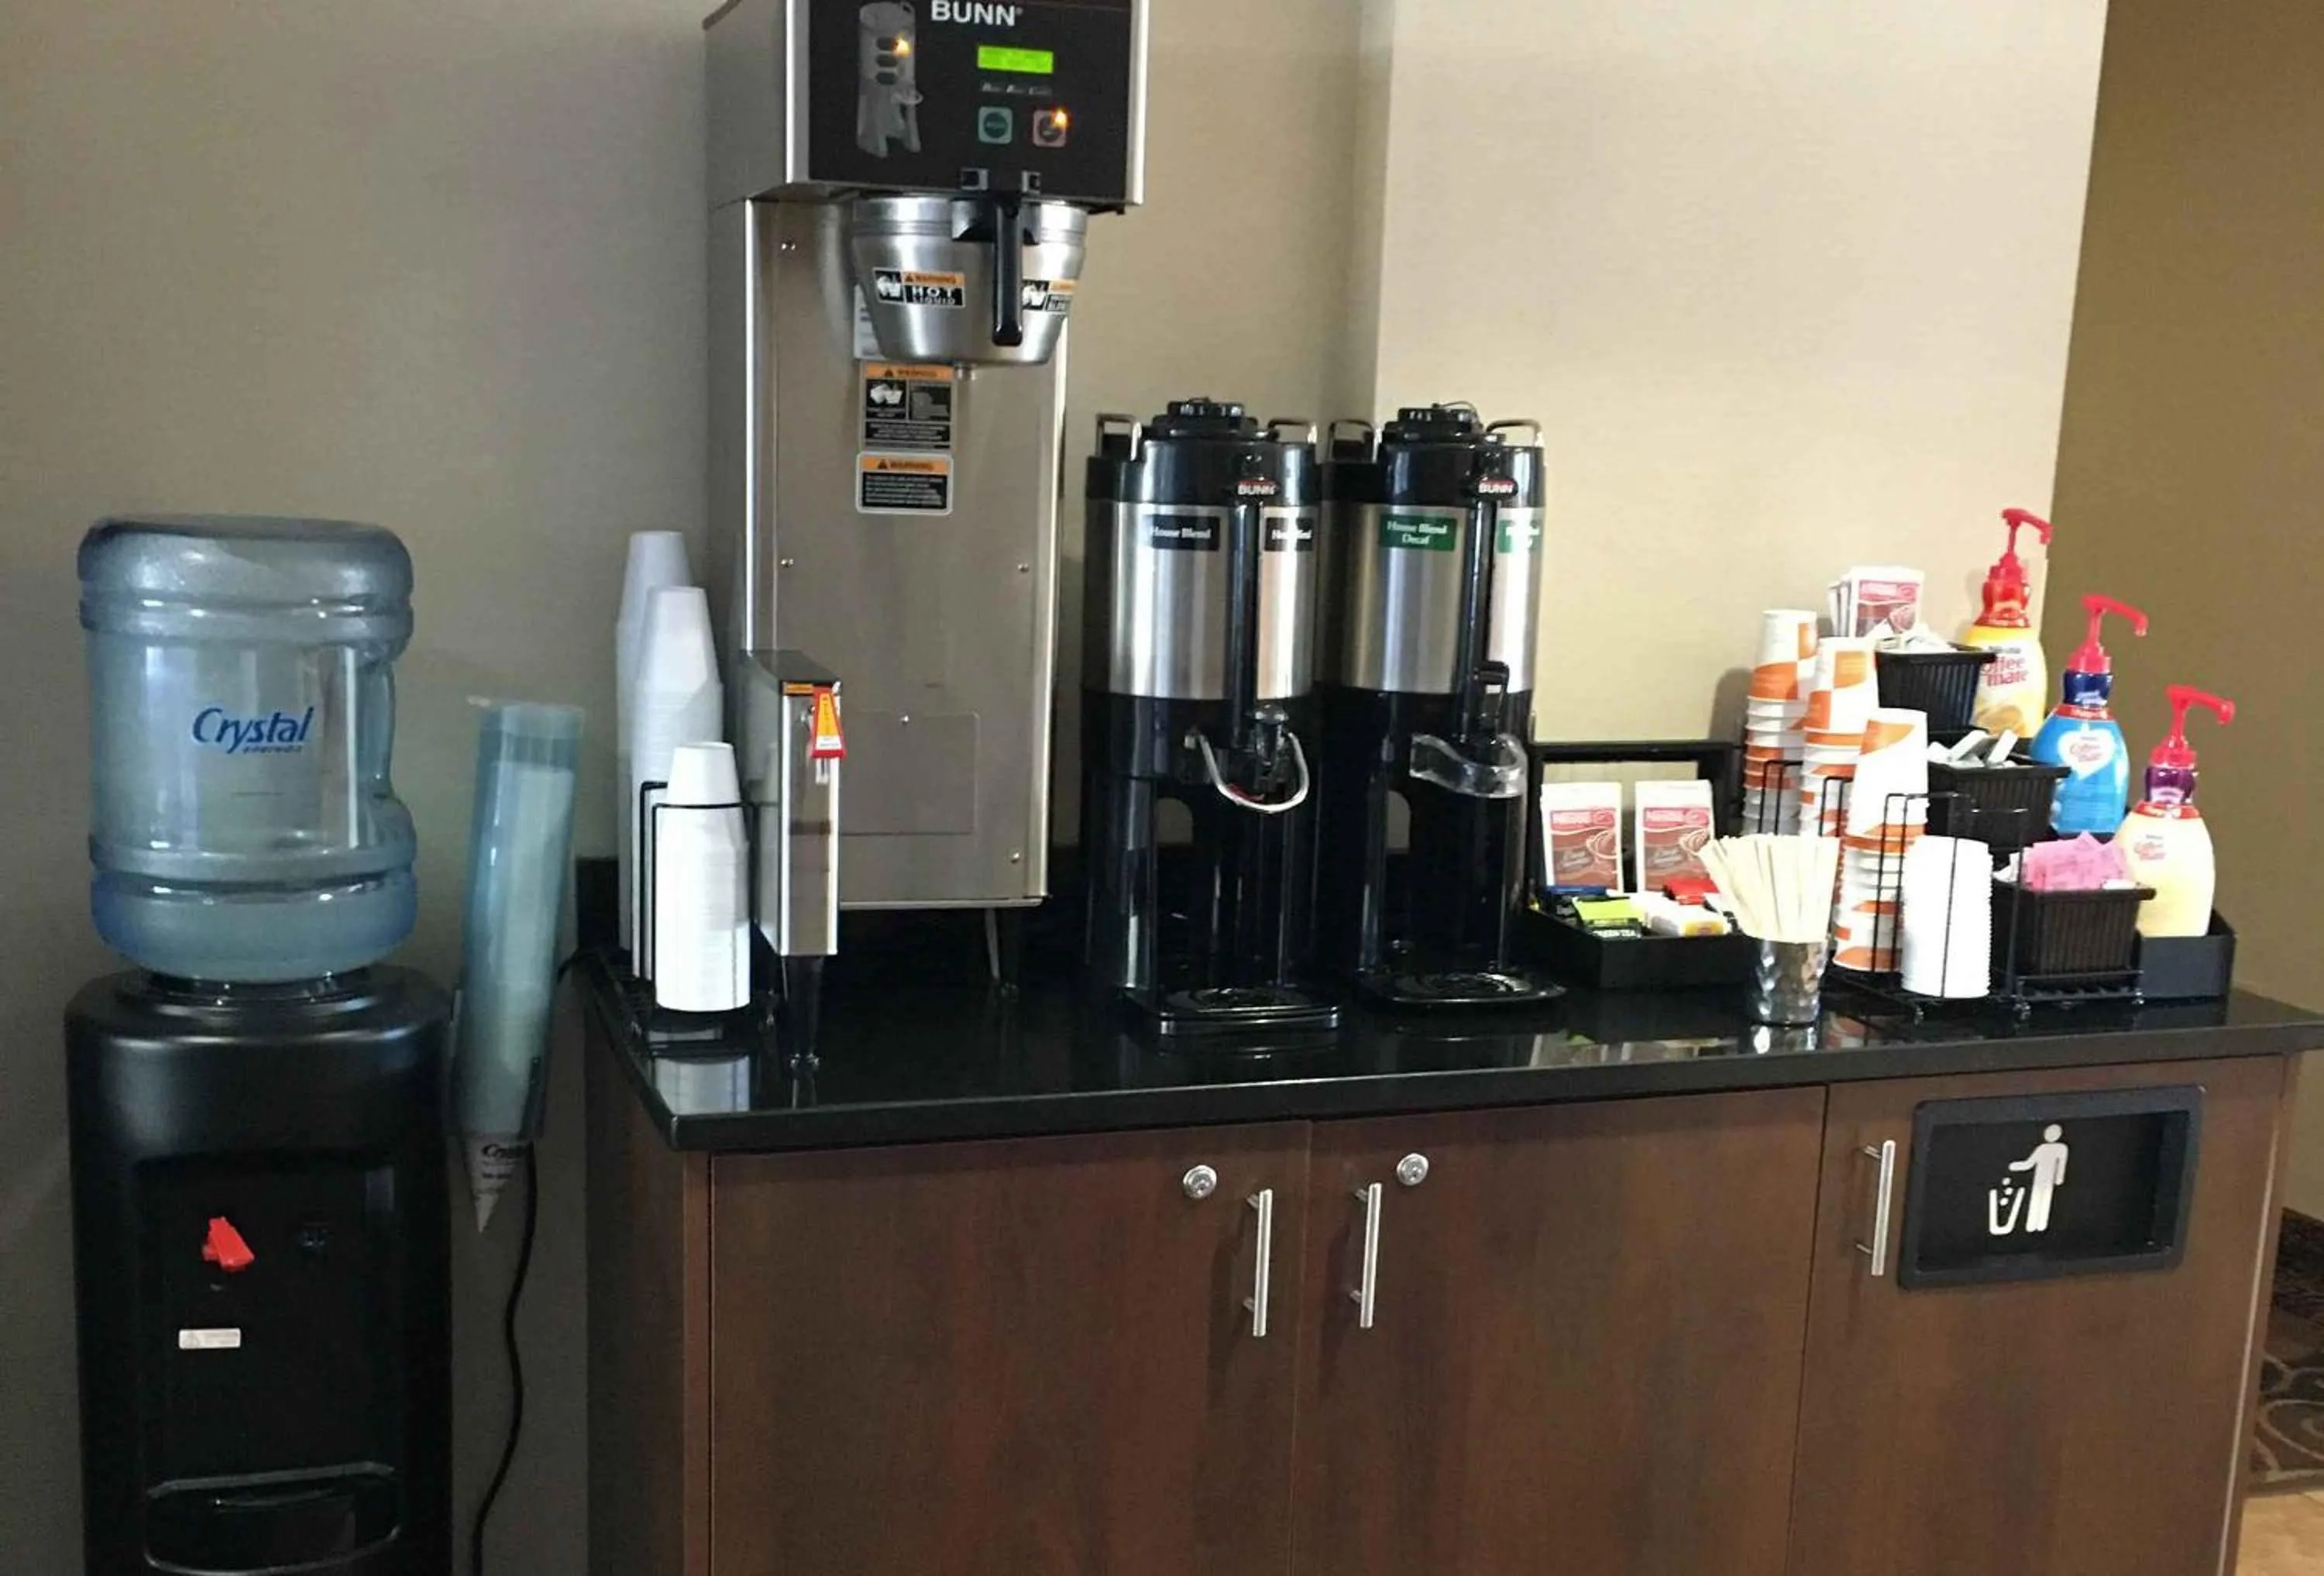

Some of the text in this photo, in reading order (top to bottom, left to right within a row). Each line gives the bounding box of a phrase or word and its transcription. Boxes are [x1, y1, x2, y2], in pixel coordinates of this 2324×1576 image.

[931, 0, 1015, 26] BUNN
[912, 285, 956, 298] HOT
[1238, 482, 1275, 495] BUNN
[1478, 481, 1514, 494] BUNN
[1181, 528, 1212, 539] Blend
[1387, 520, 1448, 535] House Blend
[1401, 532, 1430, 545] Decaf
[1981, 656, 2026, 674] offee
[193, 705, 315, 754] Crystal
